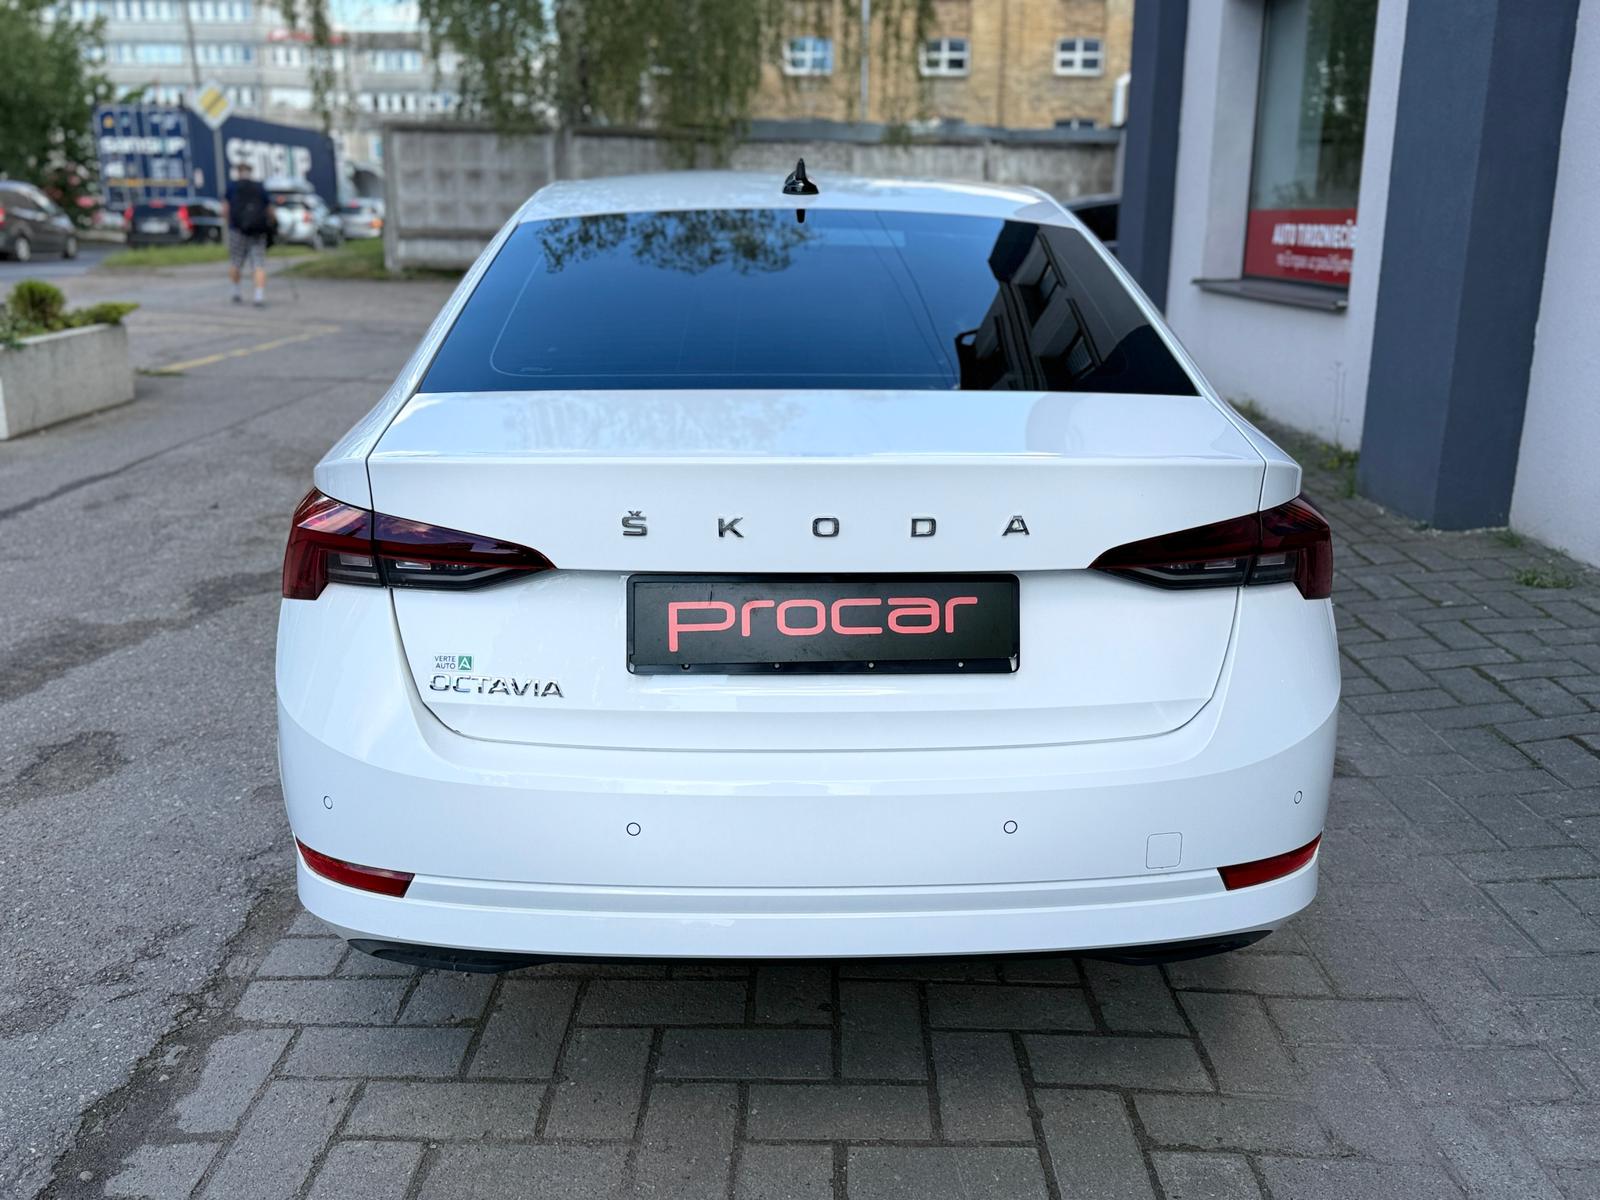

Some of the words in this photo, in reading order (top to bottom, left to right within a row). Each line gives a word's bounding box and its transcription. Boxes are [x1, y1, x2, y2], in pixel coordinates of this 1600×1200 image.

[1273, 223, 1296, 245] AUTO
[622, 510, 1030, 538] ŠKODA
[667, 596, 978, 653] procar
[435, 662, 456, 670] AUTO
[429, 674, 564, 698] OCTAVIA
